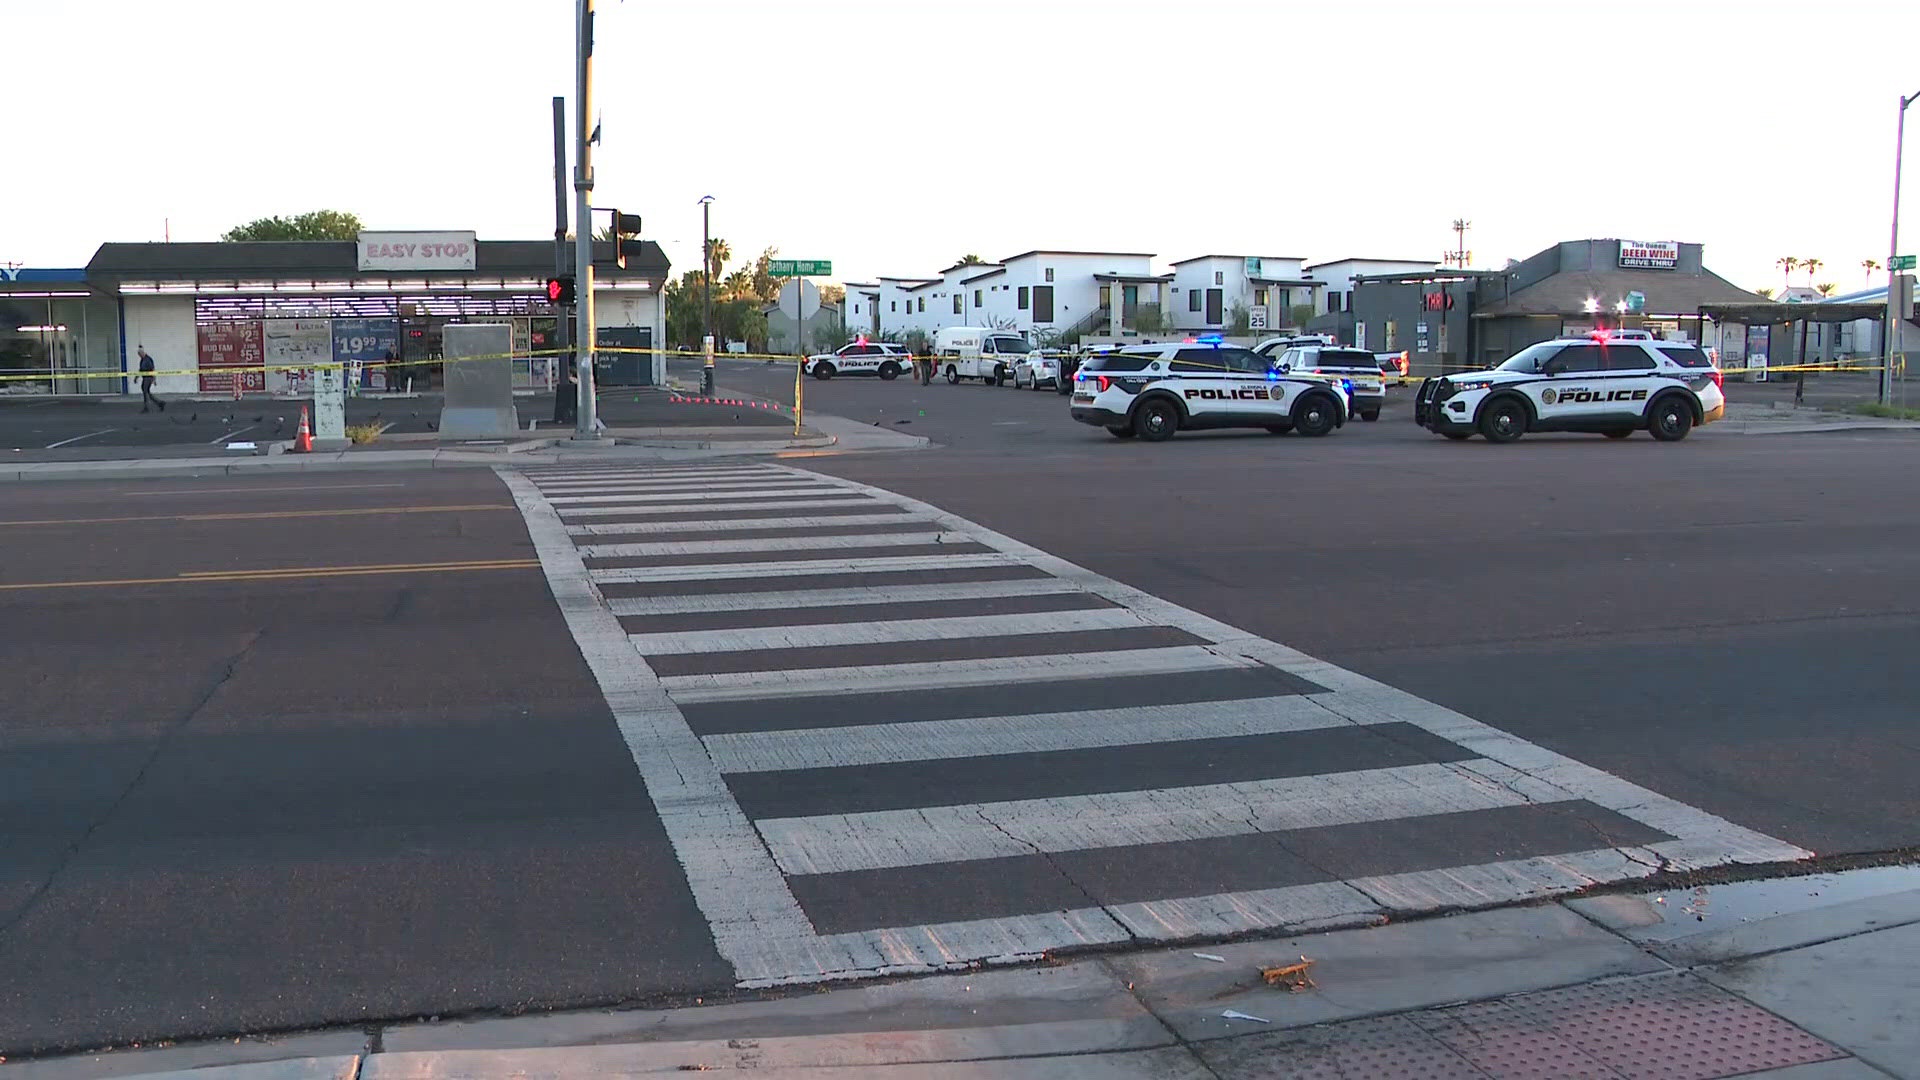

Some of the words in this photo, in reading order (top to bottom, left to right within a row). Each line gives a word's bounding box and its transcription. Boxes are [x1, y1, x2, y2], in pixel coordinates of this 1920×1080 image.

[367, 243, 416, 258] EASY
[421, 243, 470, 258] STOP
[1622, 249, 1647, 258] BEER
[1649, 249, 1676, 258] WINE
[768, 260, 794, 275] Bethany
[796, 261, 815, 272] Home
[1624, 258, 1649, 266] DRIVE
[1651, 259, 1673, 267] THRU
[1427, 293, 1444, 312] THR
[1251, 317, 1265, 327] 25
[218, 325, 233, 333] FAM
[202, 344, 218, 352] BUD
[219, 344, 233, 352] FAM
[1184, 389, 1269, 400] POLICE
[1557, 389, 1648, 404] POLICE
